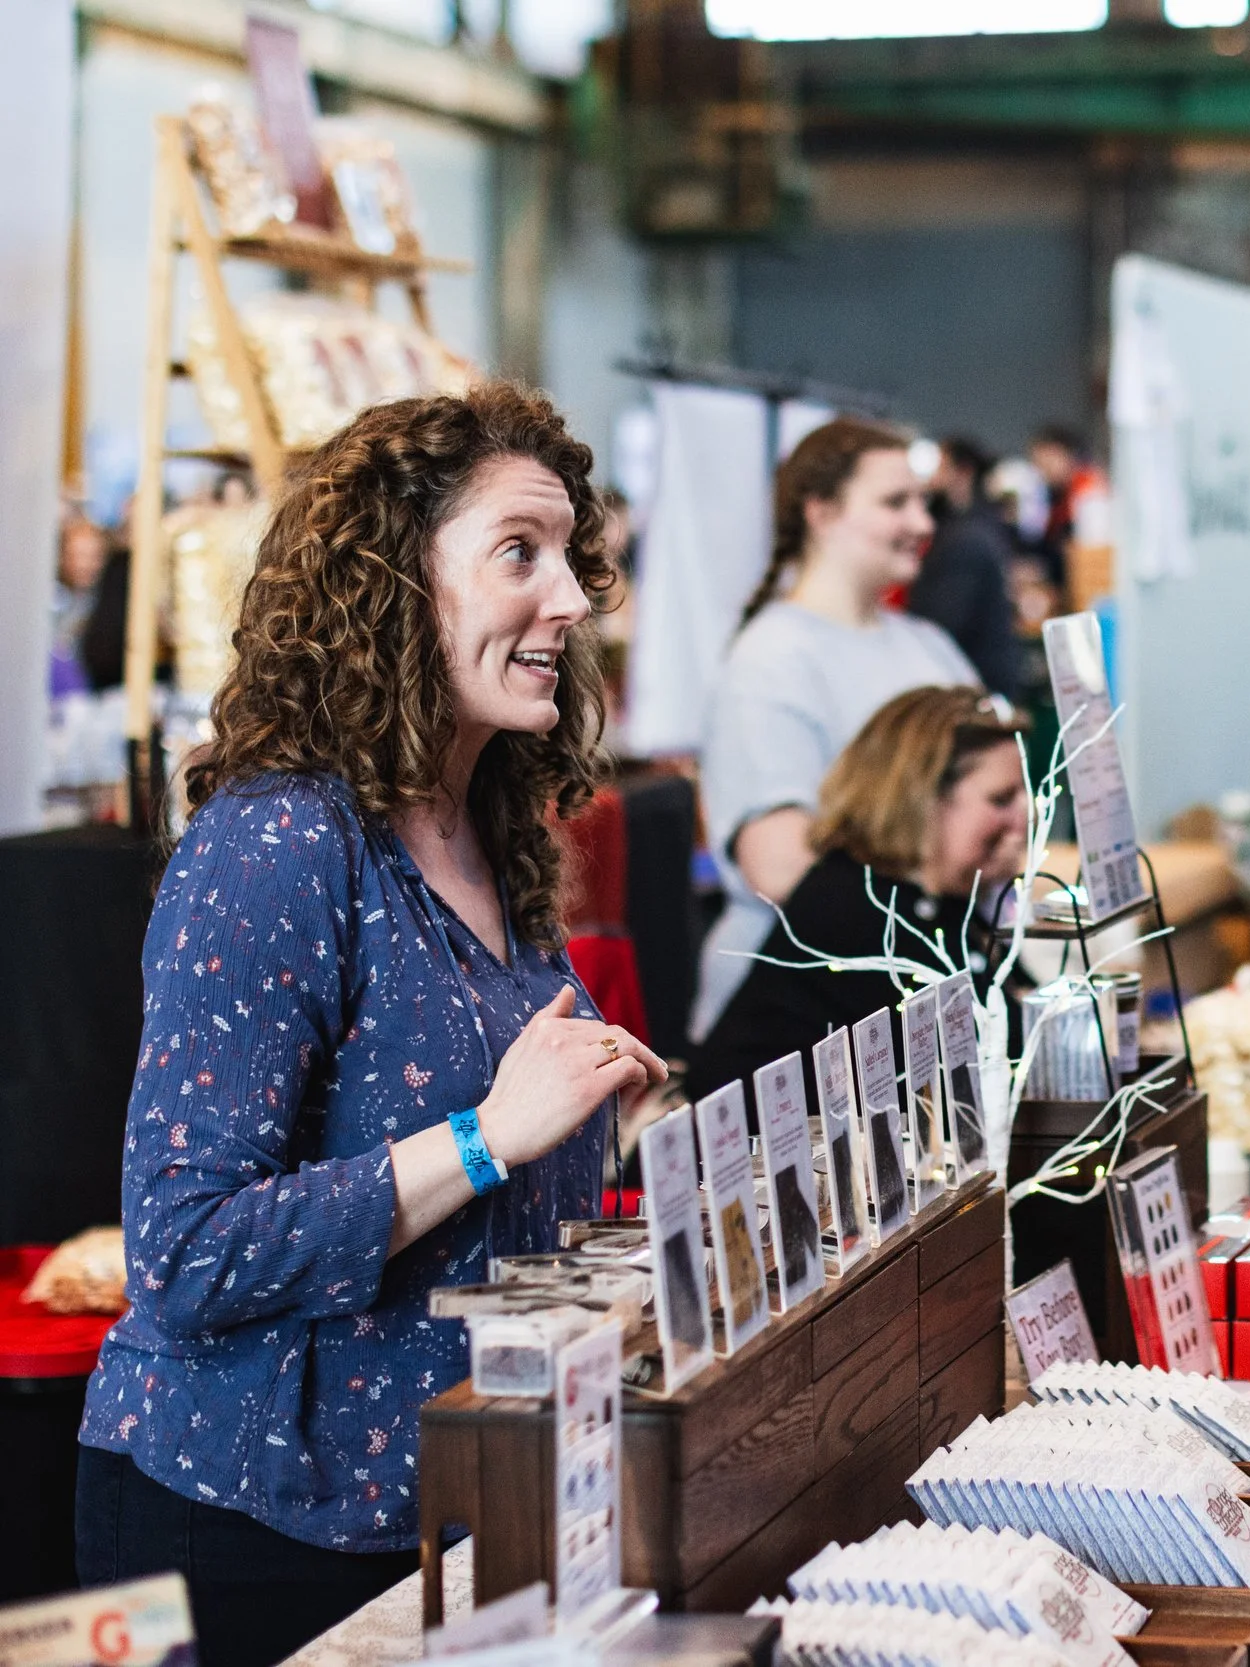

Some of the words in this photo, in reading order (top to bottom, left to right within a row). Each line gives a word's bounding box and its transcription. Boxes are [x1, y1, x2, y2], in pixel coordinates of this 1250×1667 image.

[1018, 1315, 1045, 1347] Try
[1040, 1291, 1078, 1330] Before
[90, 1609, 131, 1664] G
